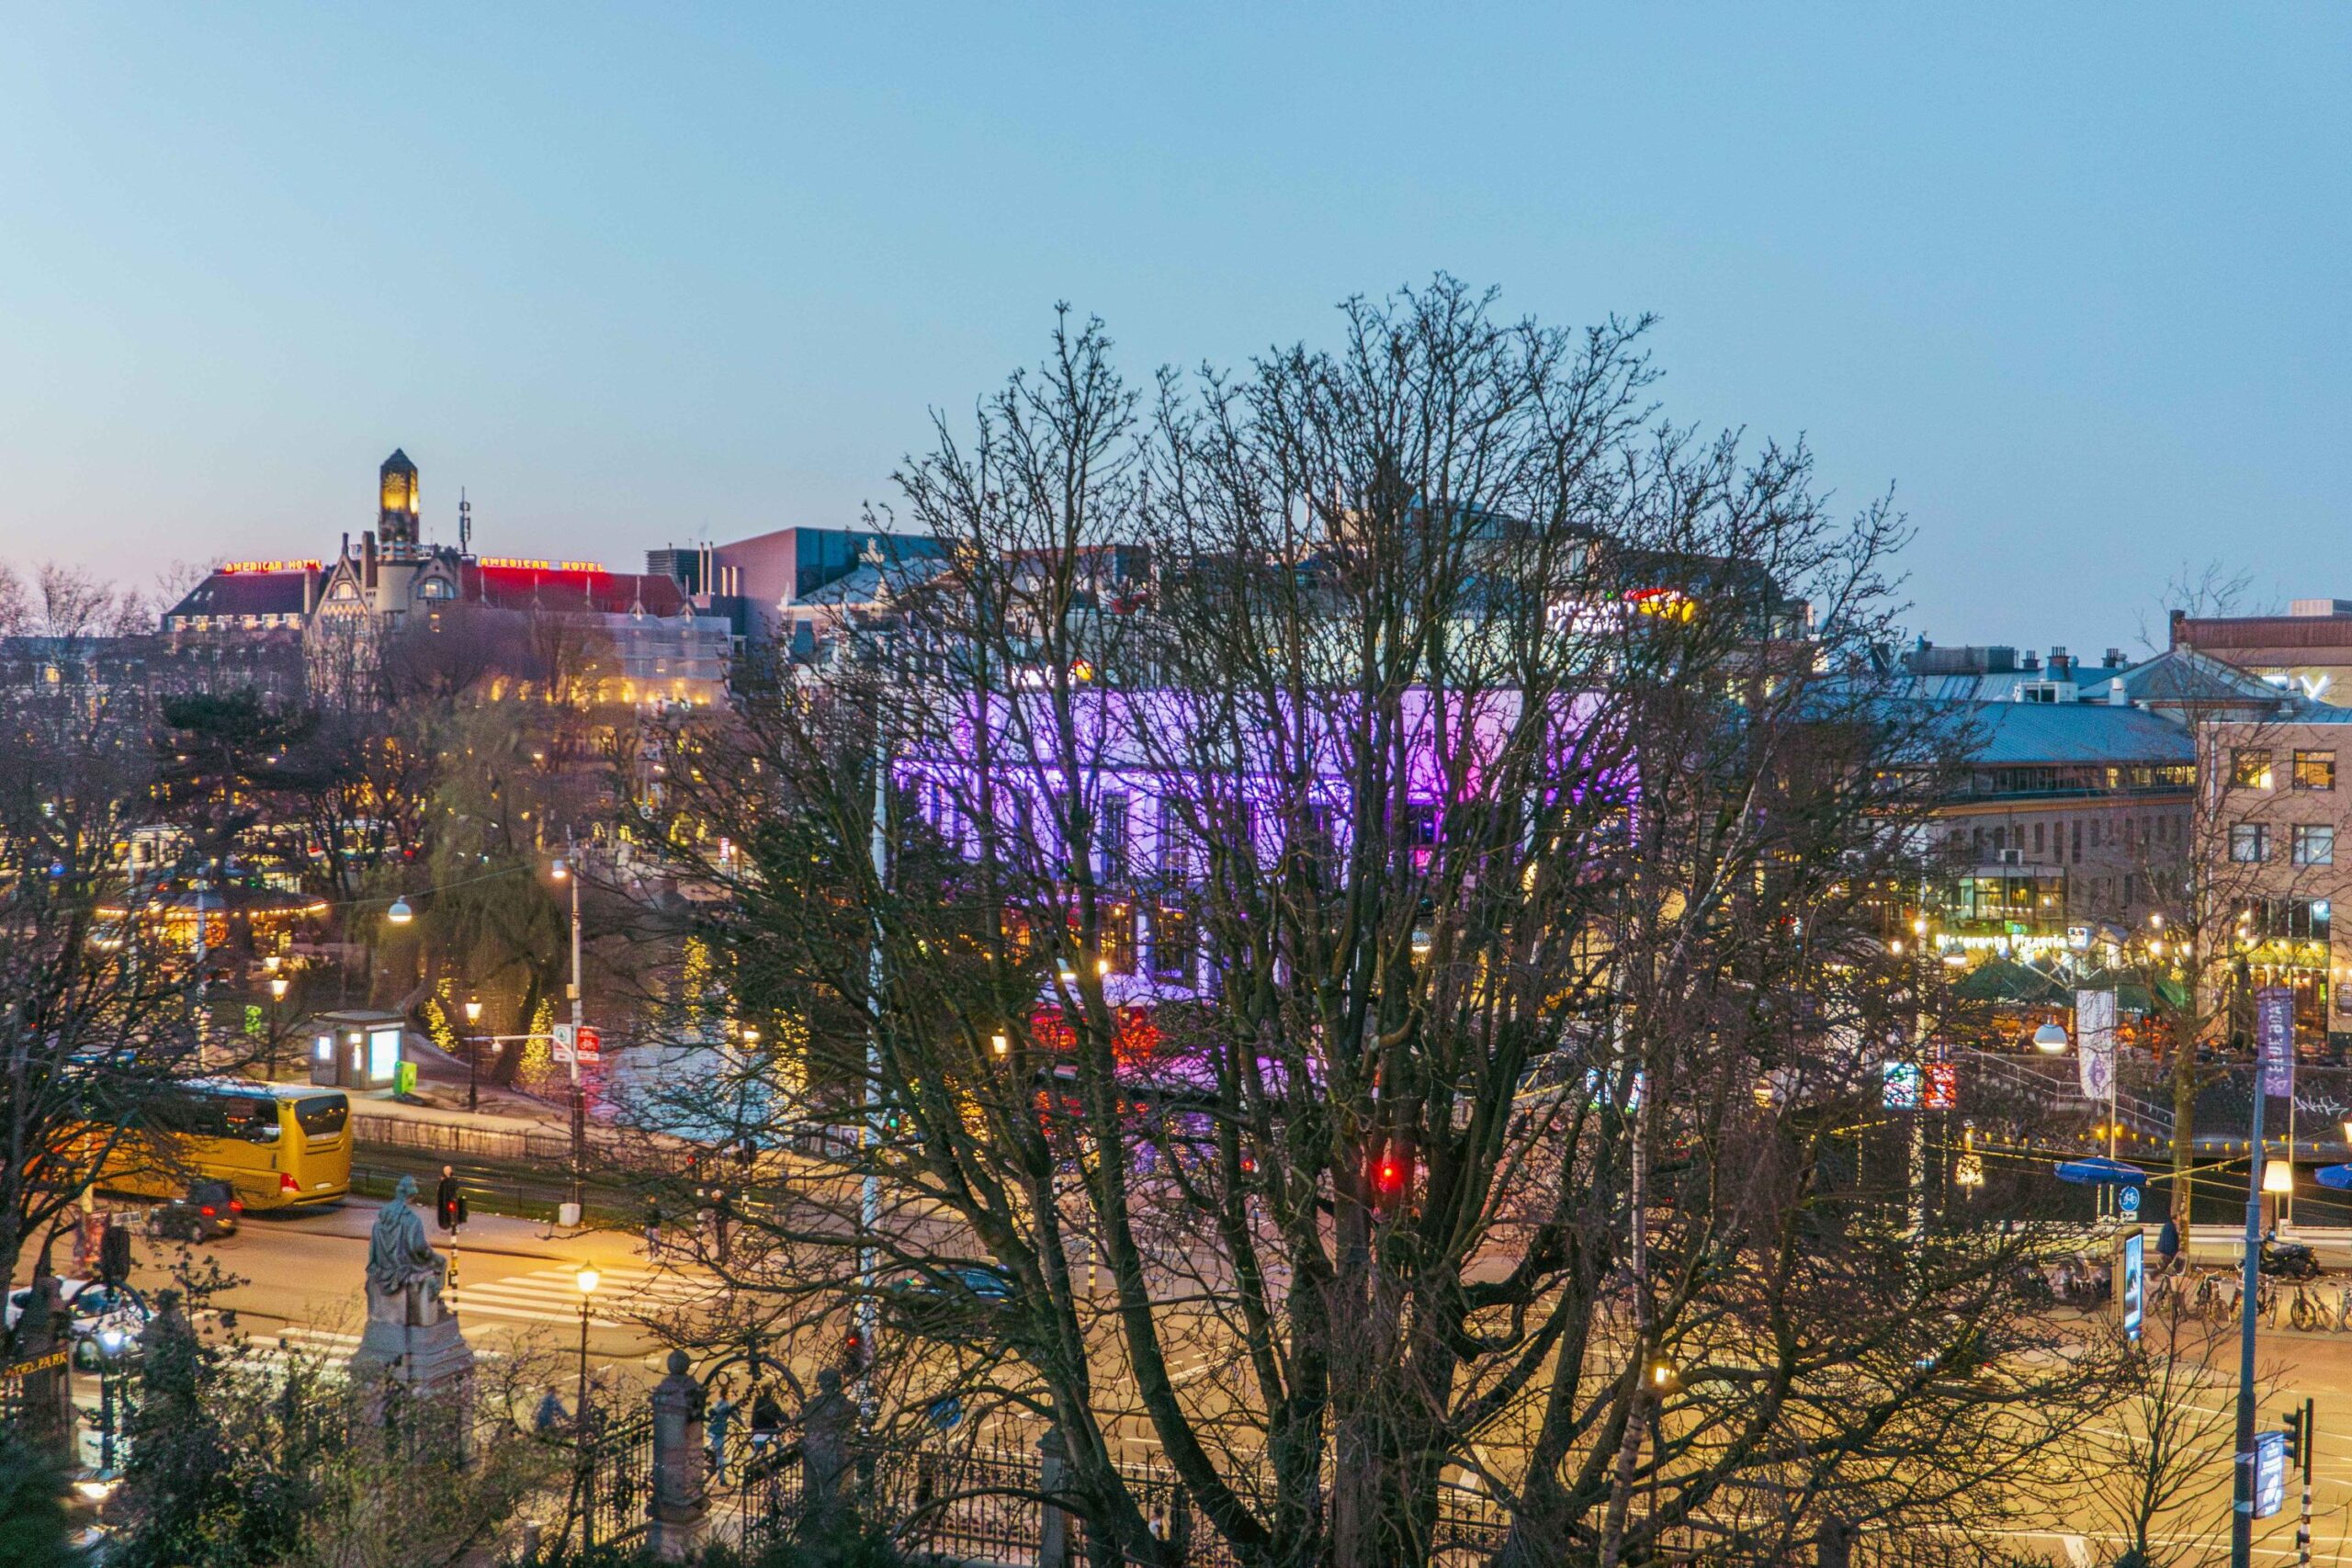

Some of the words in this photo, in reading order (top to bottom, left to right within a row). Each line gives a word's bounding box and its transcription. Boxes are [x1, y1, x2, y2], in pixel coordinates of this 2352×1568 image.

[224, 560, 283, 573] AMERICAN
[288, 558, 322, 571] HOTEL
[481, 557, 549, 569] AMERICAN
[561, 560, 604, 572] HOTEL
